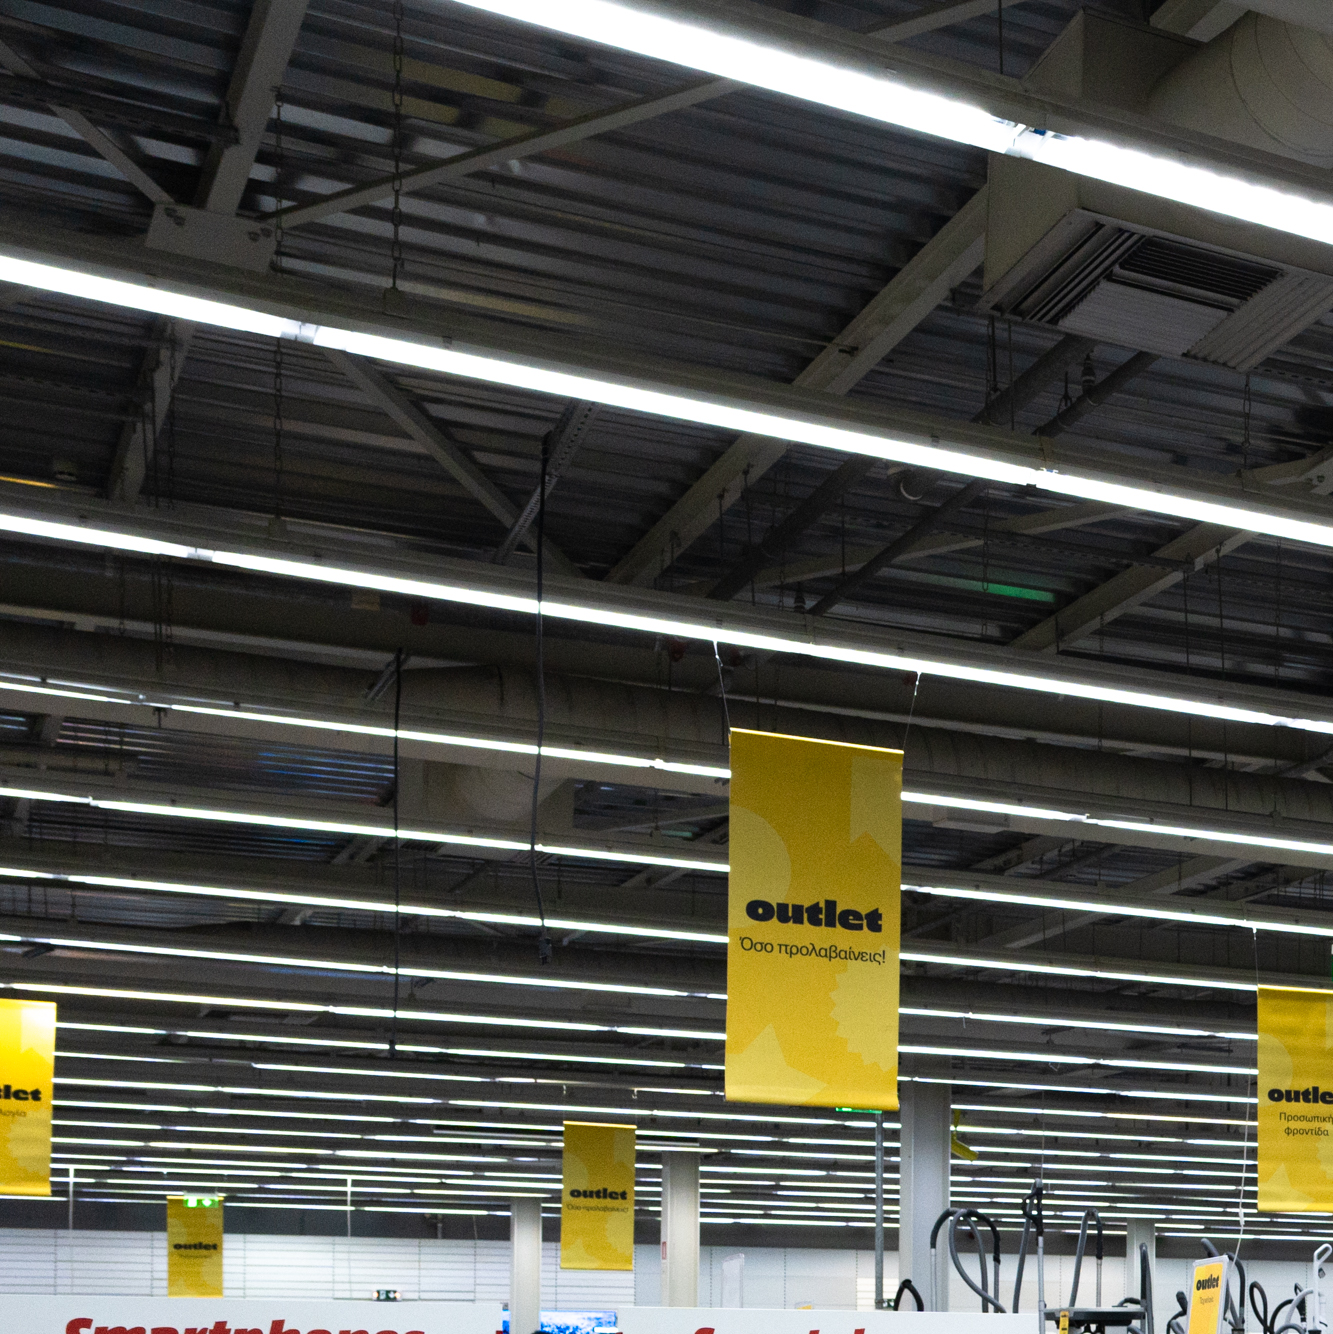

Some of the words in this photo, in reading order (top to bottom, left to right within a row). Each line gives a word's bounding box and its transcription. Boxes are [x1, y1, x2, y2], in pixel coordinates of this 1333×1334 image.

[746, 899, 883, 933] outlet
[739, 936, 774, 953] Όσο
[778, 943, 886, 965] προλαβαίνεις!
[1279, 1111, 1333, 1125] Προσωπική
[1284, 1127, 1330, 1136] φροντίδα
[570, 1188, 627, 1200] outlet
[1196, 1274, 1219, 1291] outlet
